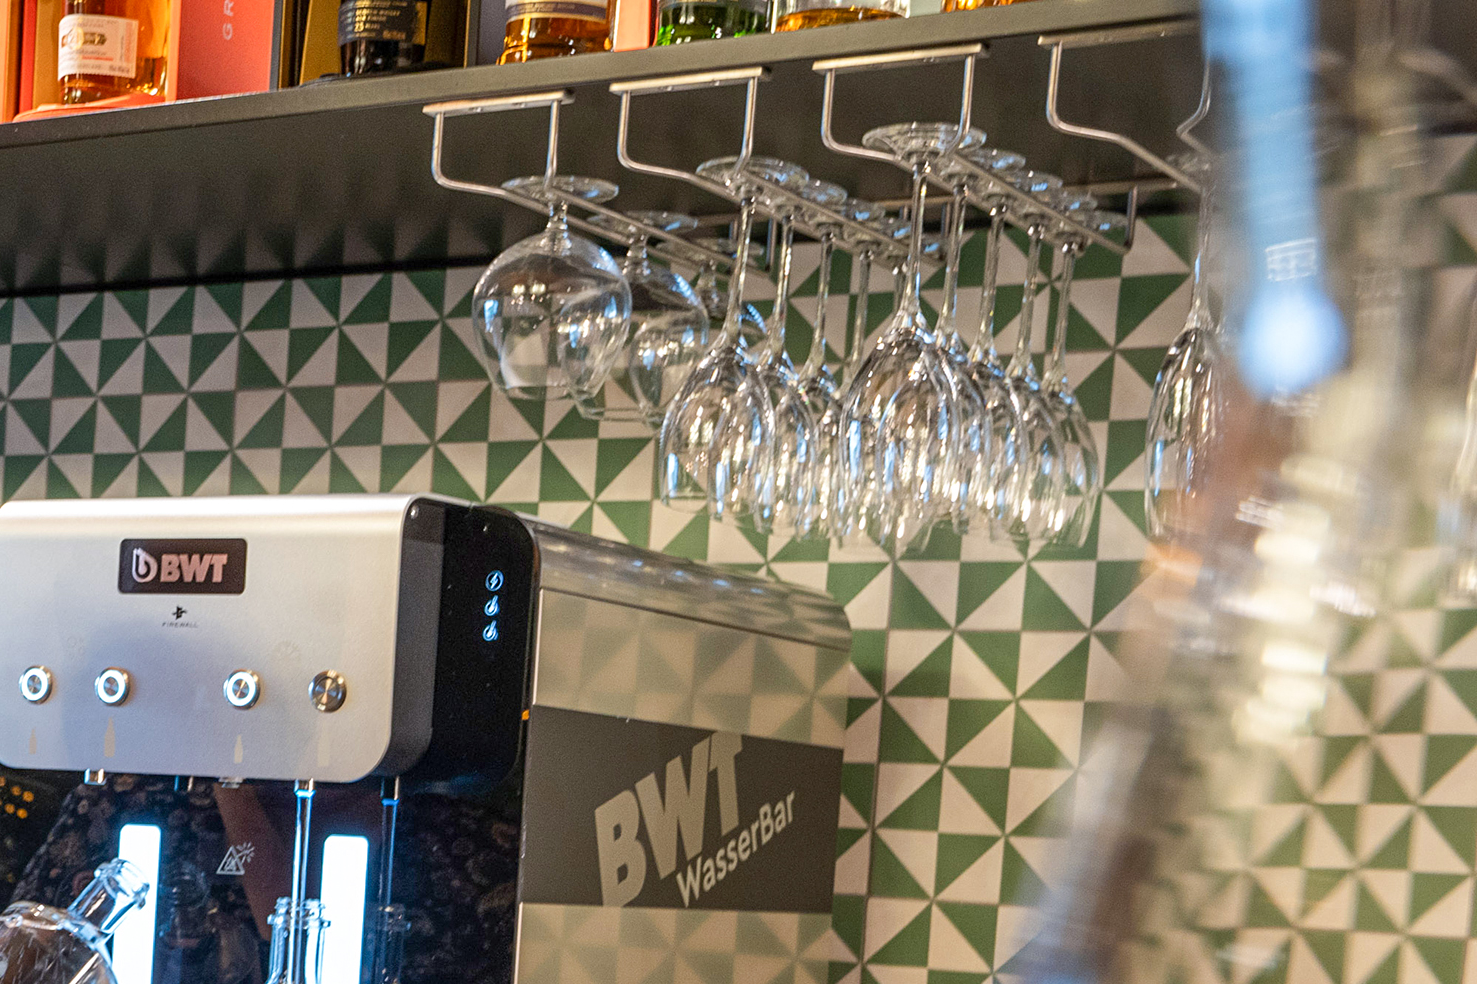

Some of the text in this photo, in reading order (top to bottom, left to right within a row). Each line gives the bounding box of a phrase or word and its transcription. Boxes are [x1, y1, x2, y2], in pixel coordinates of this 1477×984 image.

[160, 553, 228, 583] BWT
[594, 730, 743, 908] BWT
[676, 790, 795, 908] WasserBar
